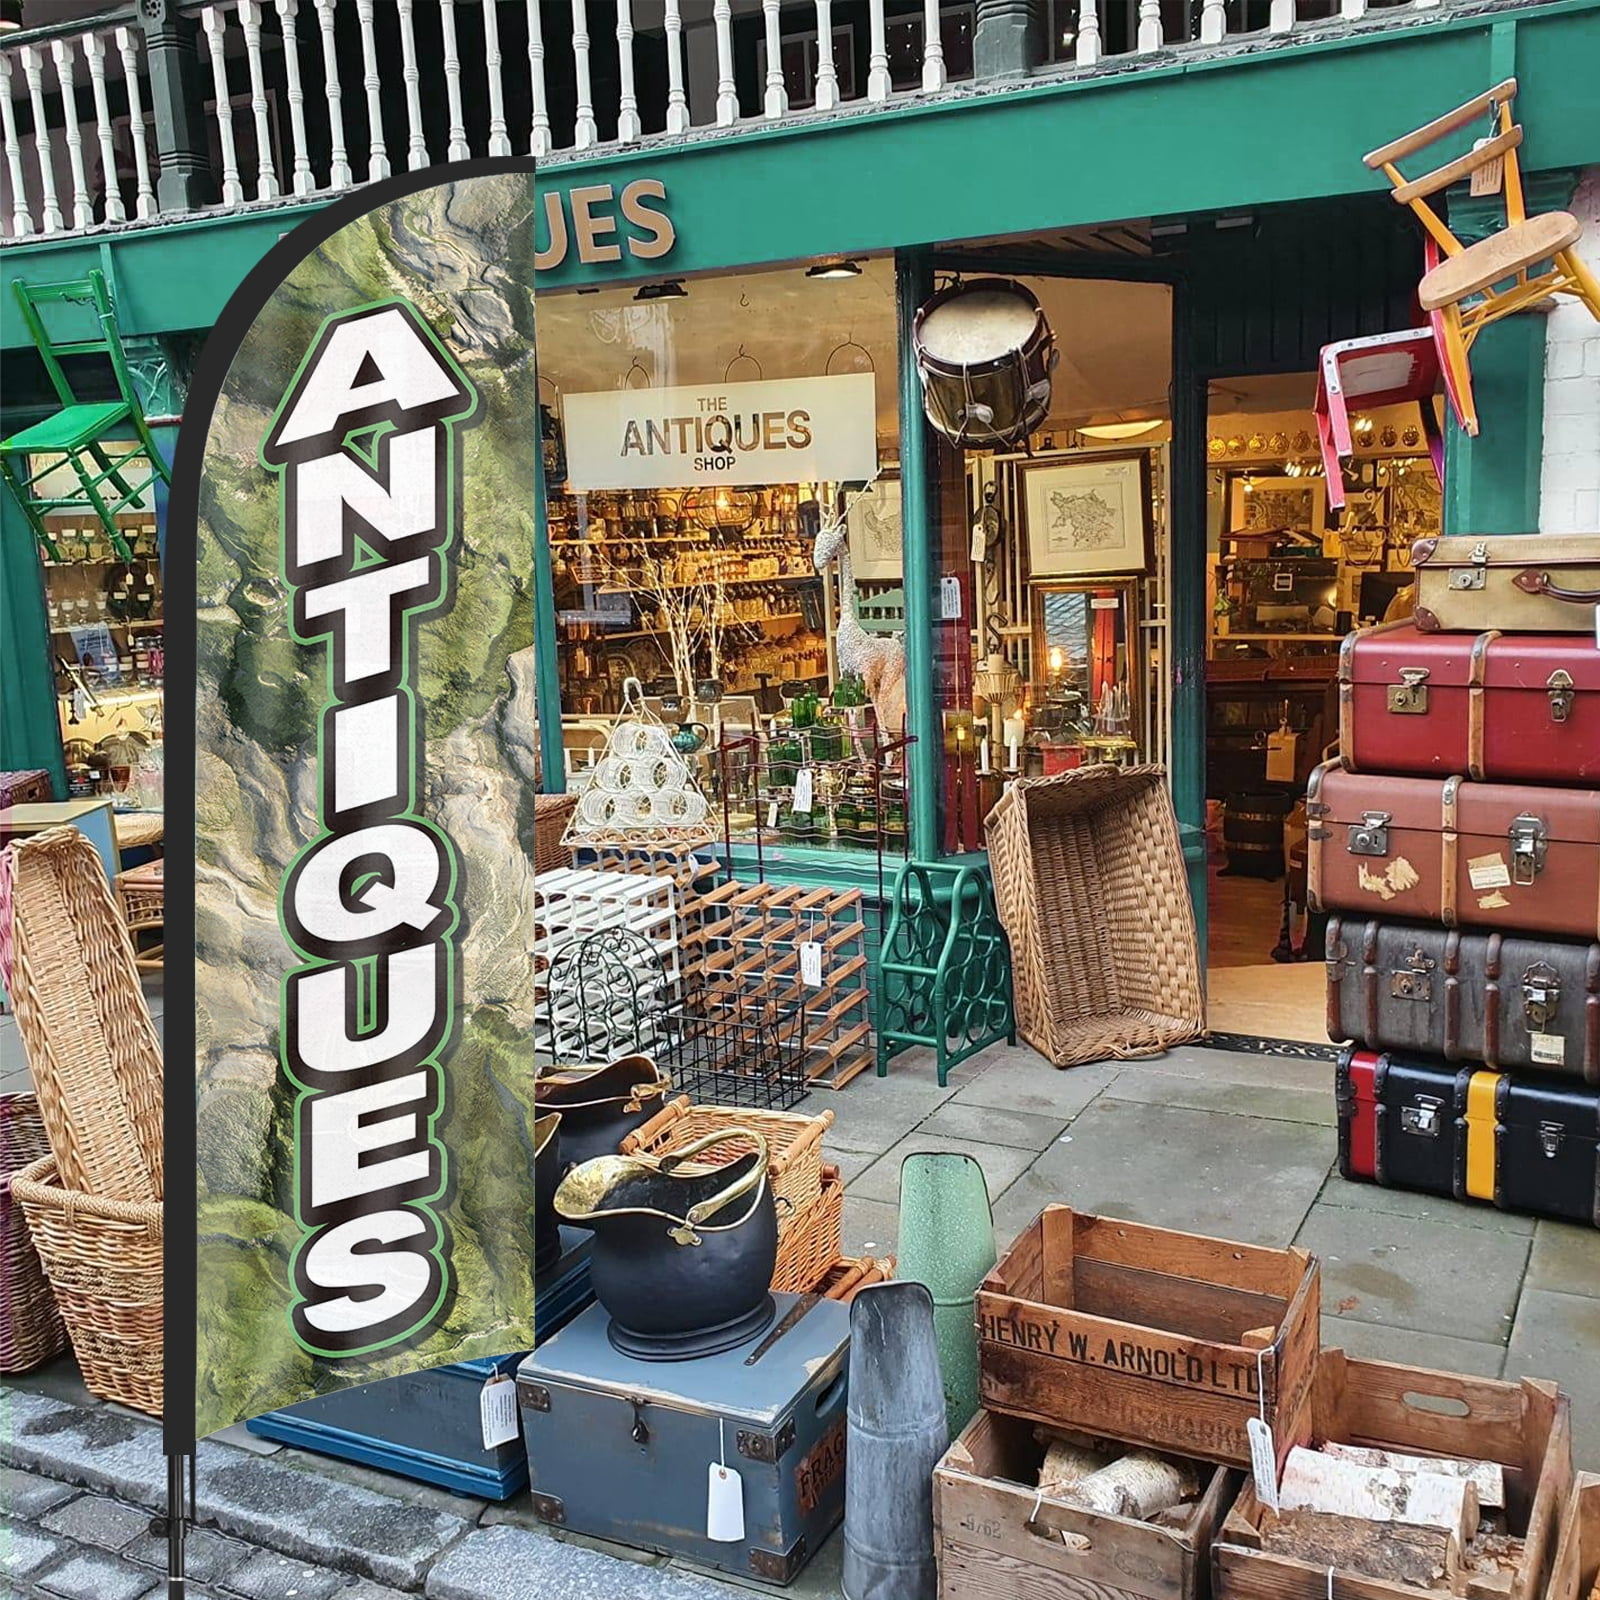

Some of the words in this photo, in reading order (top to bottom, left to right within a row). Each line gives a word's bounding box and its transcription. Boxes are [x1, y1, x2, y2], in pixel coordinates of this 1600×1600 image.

[697, 397, 727, 411] THE
[620, 410, 812, 456] ANTIQUES
[694, 456, 736, 471] SHOP
[272, 306, 462, 1335] ANTIQUES
[980, 1313, 1060, 1353] HENRY
[1069, 1332, 1097, 1361] W.
[1103, 1338, 1205, 1384] ARNOLD
